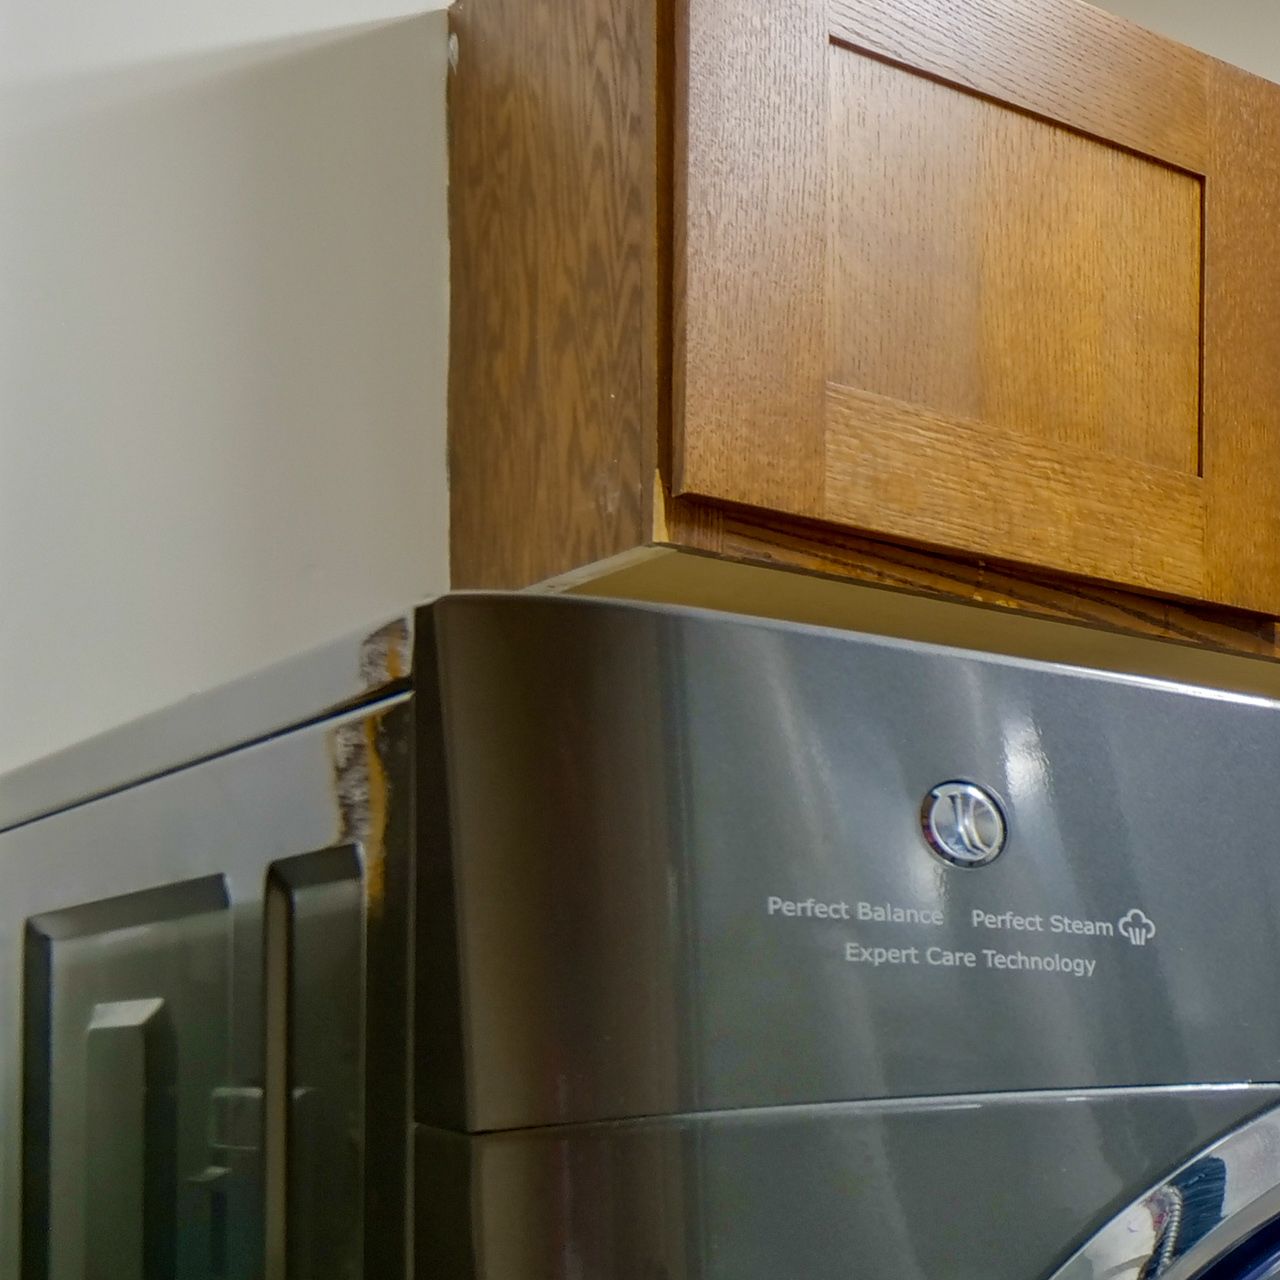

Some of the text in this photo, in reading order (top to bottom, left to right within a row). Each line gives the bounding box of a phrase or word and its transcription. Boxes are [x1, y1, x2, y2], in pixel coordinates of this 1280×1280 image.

[767, 896, 945, 926] Perfect Balance
[971, 909, 1114, 937] Perfect Steam
[845, 943, 1096, 977] Expert Care Technology
